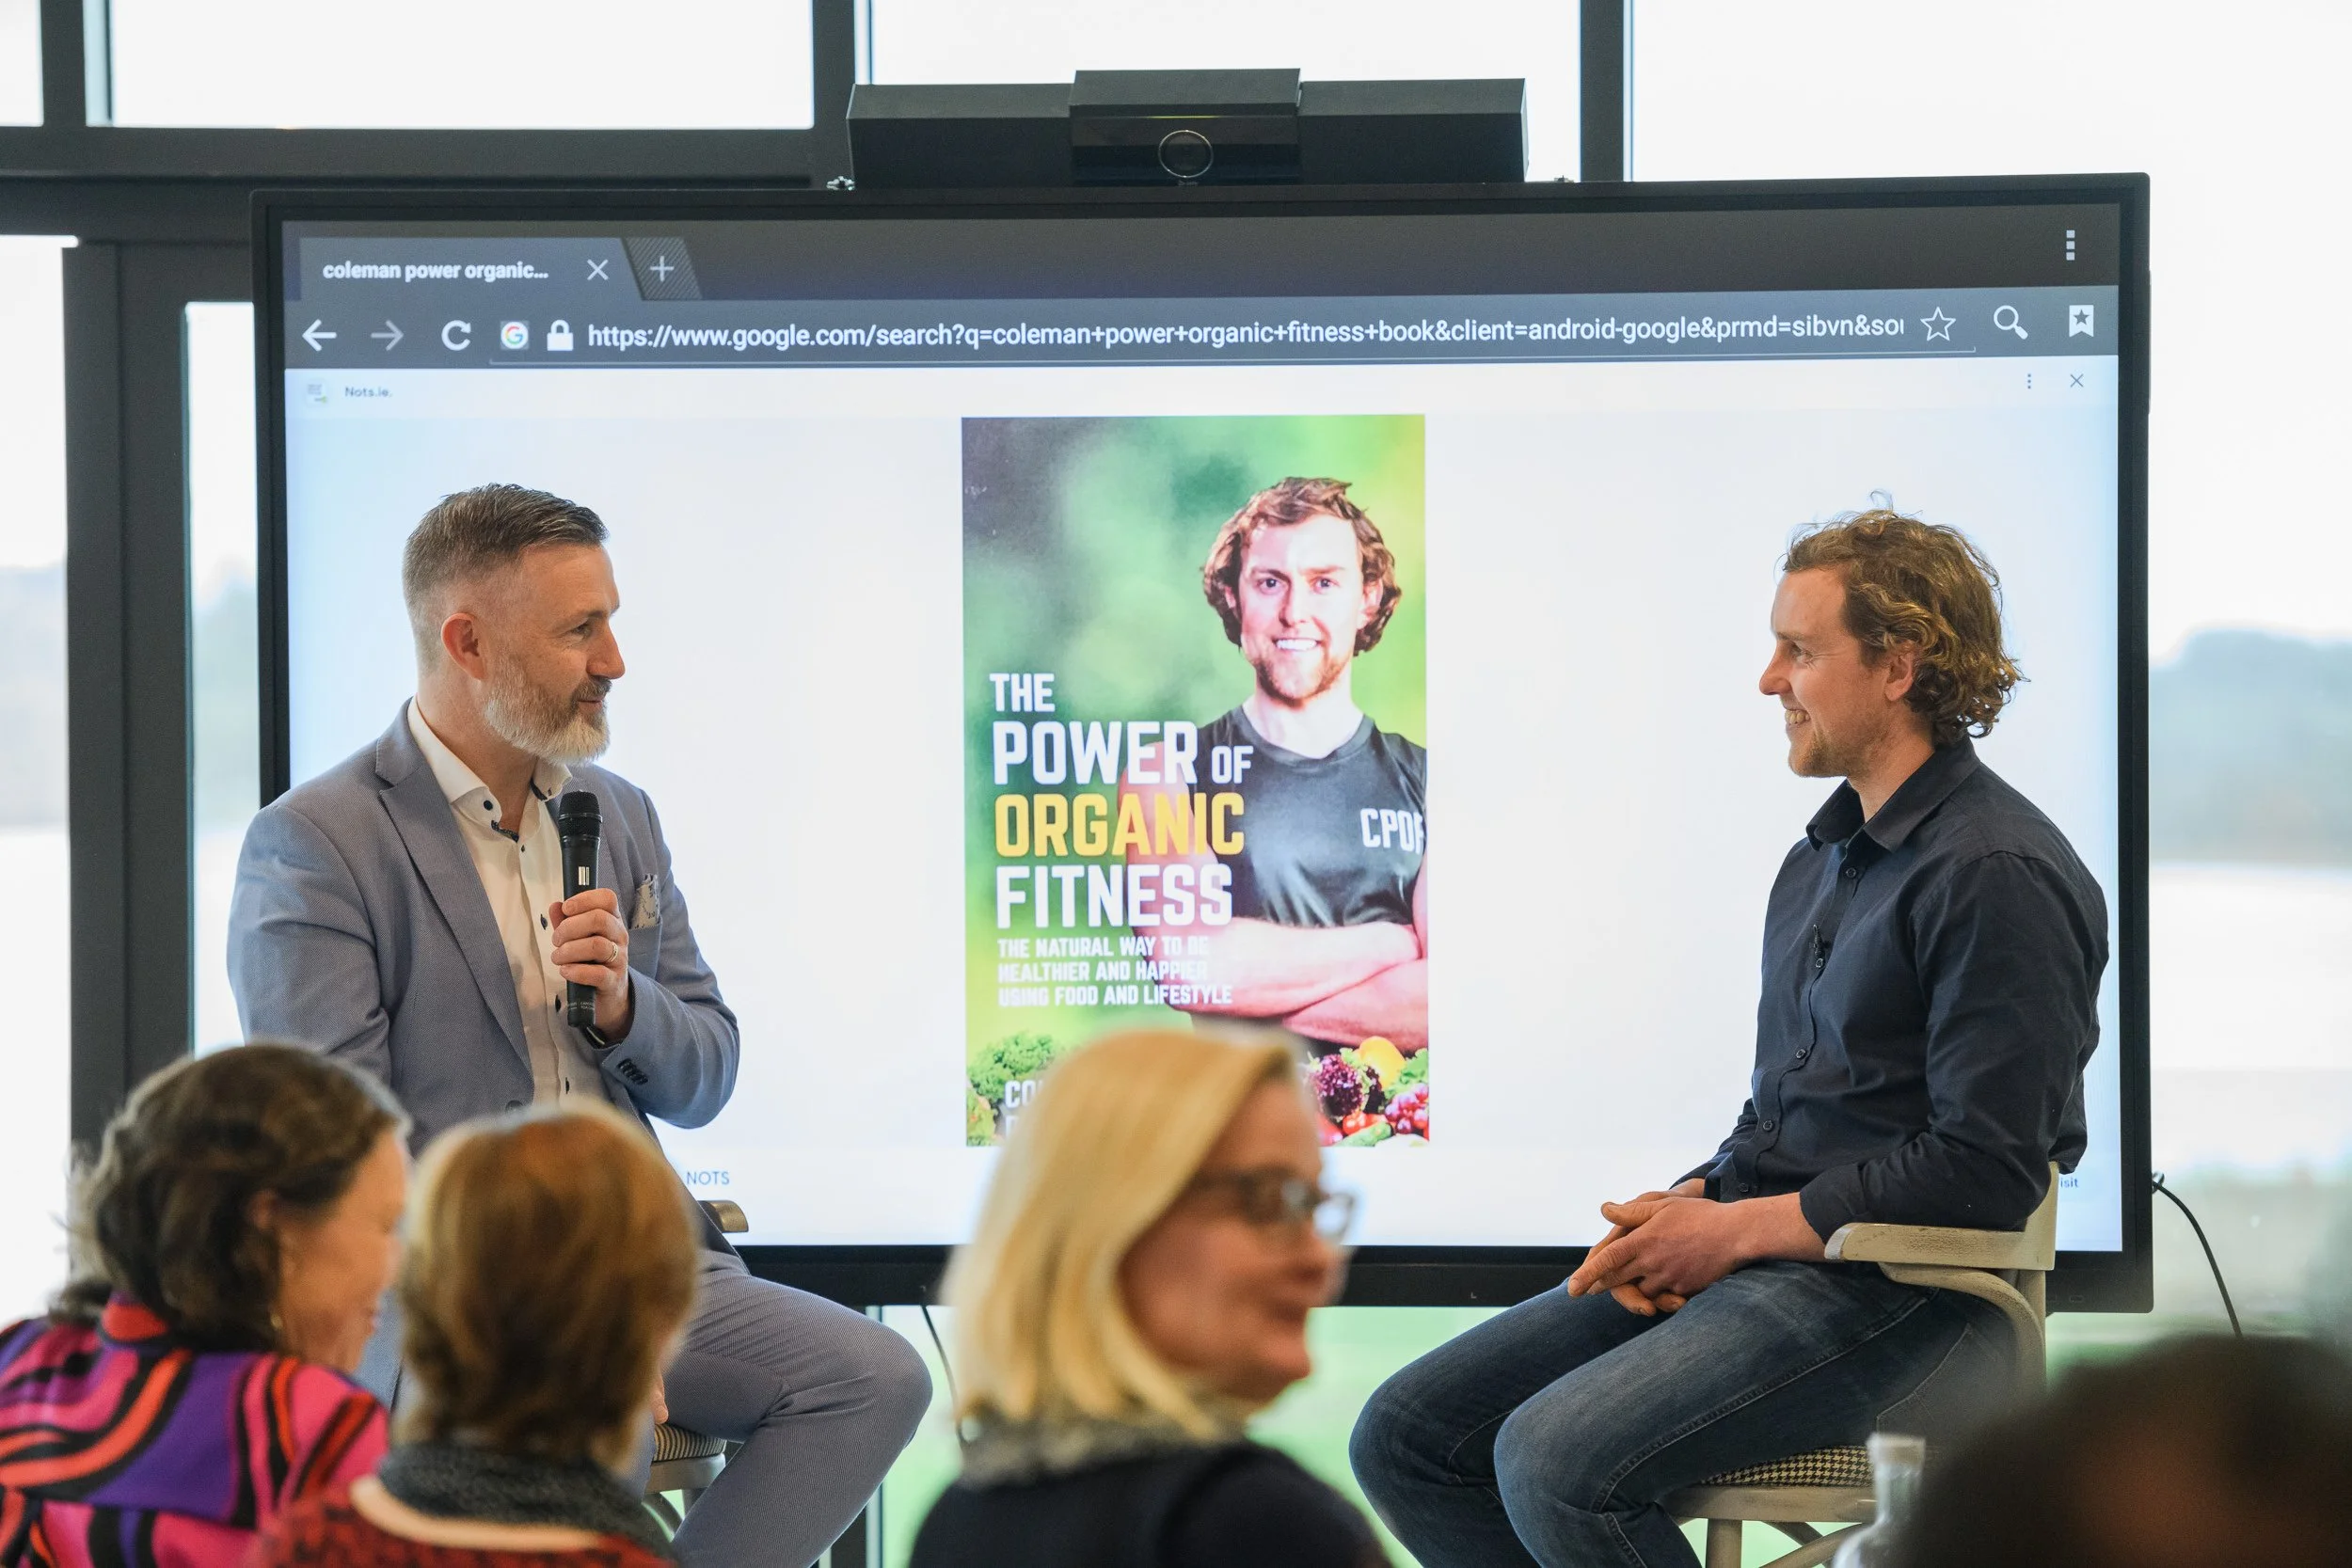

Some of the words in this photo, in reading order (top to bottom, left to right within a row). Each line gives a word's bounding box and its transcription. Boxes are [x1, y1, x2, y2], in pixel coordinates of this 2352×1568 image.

[322, 261, 402, 279] coleman
[405, 264, 461, 283] power
[990, 673, 1055, 712] THE
[993, 721, 1198, 784] POWER
[1211, 745, 1253, 784] OF
[994, 792, 1245, 857] ORGANIC
[995, 864, 1232, 929] FITNESS
[998, 939, 1030, 958] THE
[1036, 938, 1114, 958] NATURAL
[1120, 937, 1155, 957] WAY
[1161, 937, 1183, 956] TO
[1187, 936, 1210, 956] BE
[998, 962, 1090, 983] HEALTHIER
[1095, 961, 1130, 981] AND
[1136, 960, 1208, 981] HAPPIER
[998, 987, 1049, 1006] USING
[1055, 986, 1099, 1006] FOOD
[1104, 985, 1138, 1005] AND
[1143, 984, 1233, 1005] LIFESTYLE
[687, 1171, 730, 1184] NOTS
[2060, 1177, 2079, 1188] isit
